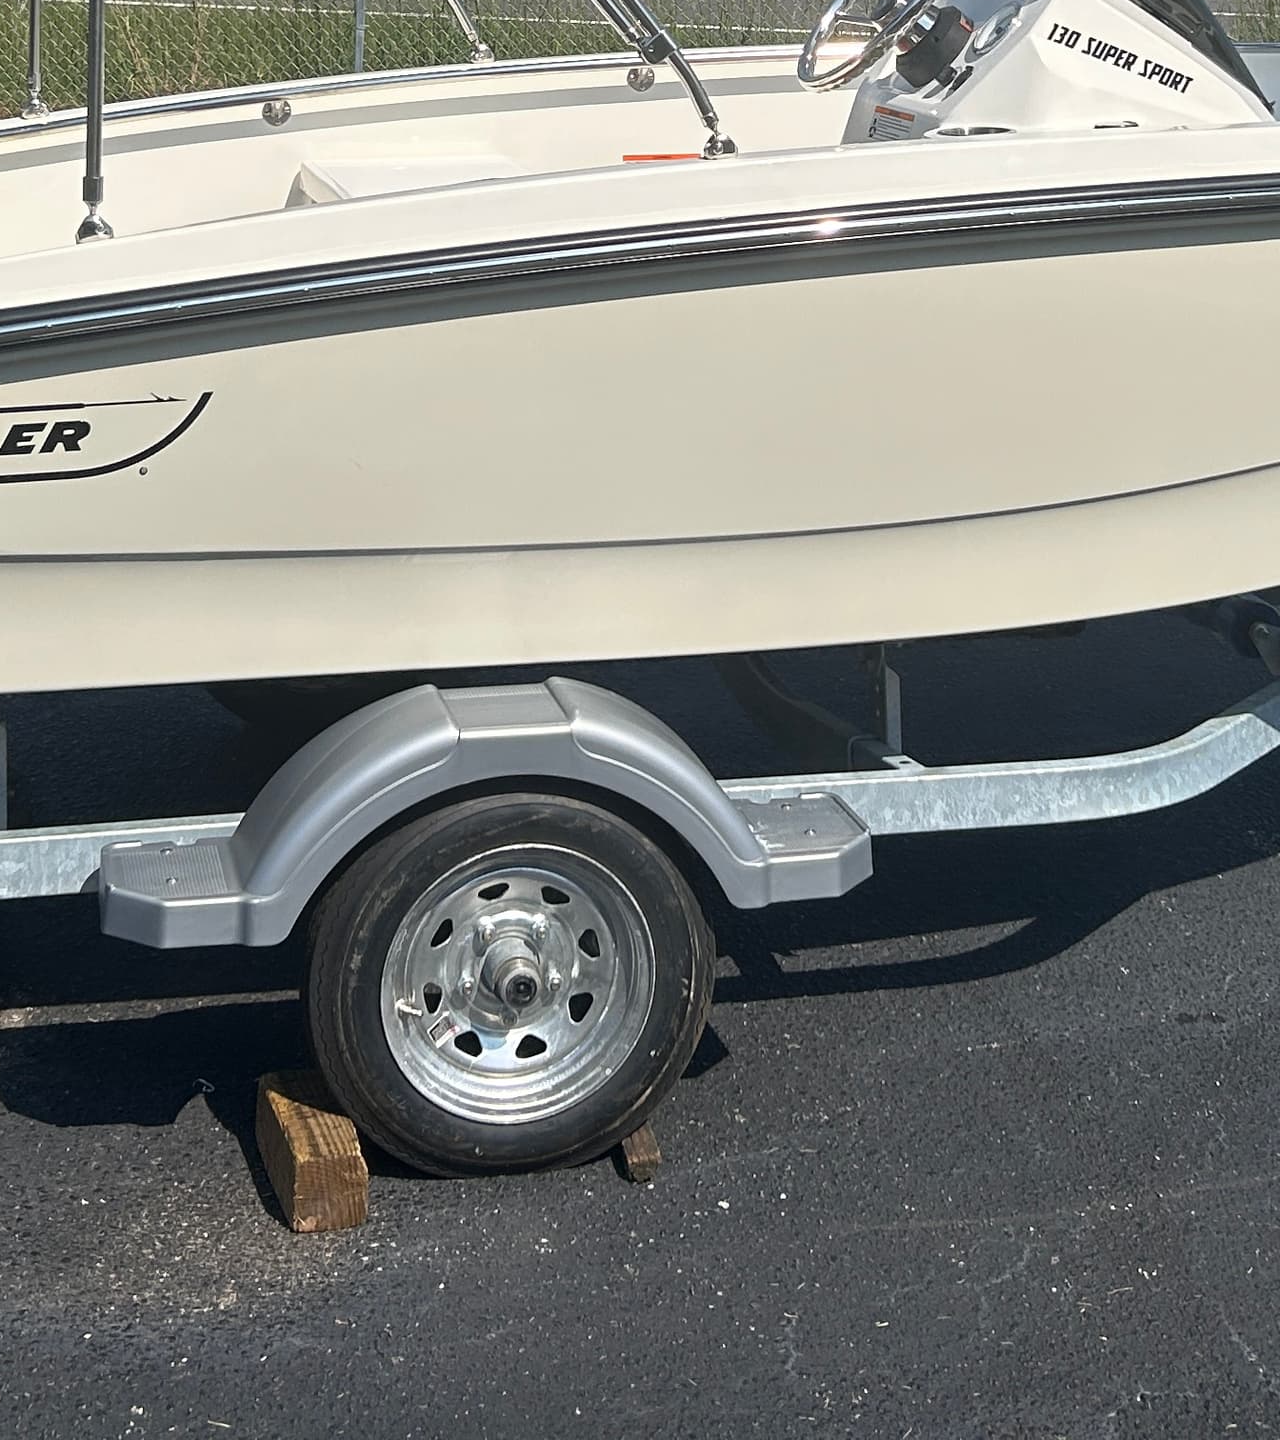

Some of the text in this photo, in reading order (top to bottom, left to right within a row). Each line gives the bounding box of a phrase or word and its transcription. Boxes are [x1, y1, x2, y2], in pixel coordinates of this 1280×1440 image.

[1046, 23, 1195, 94] 130 SUPER SPORT
